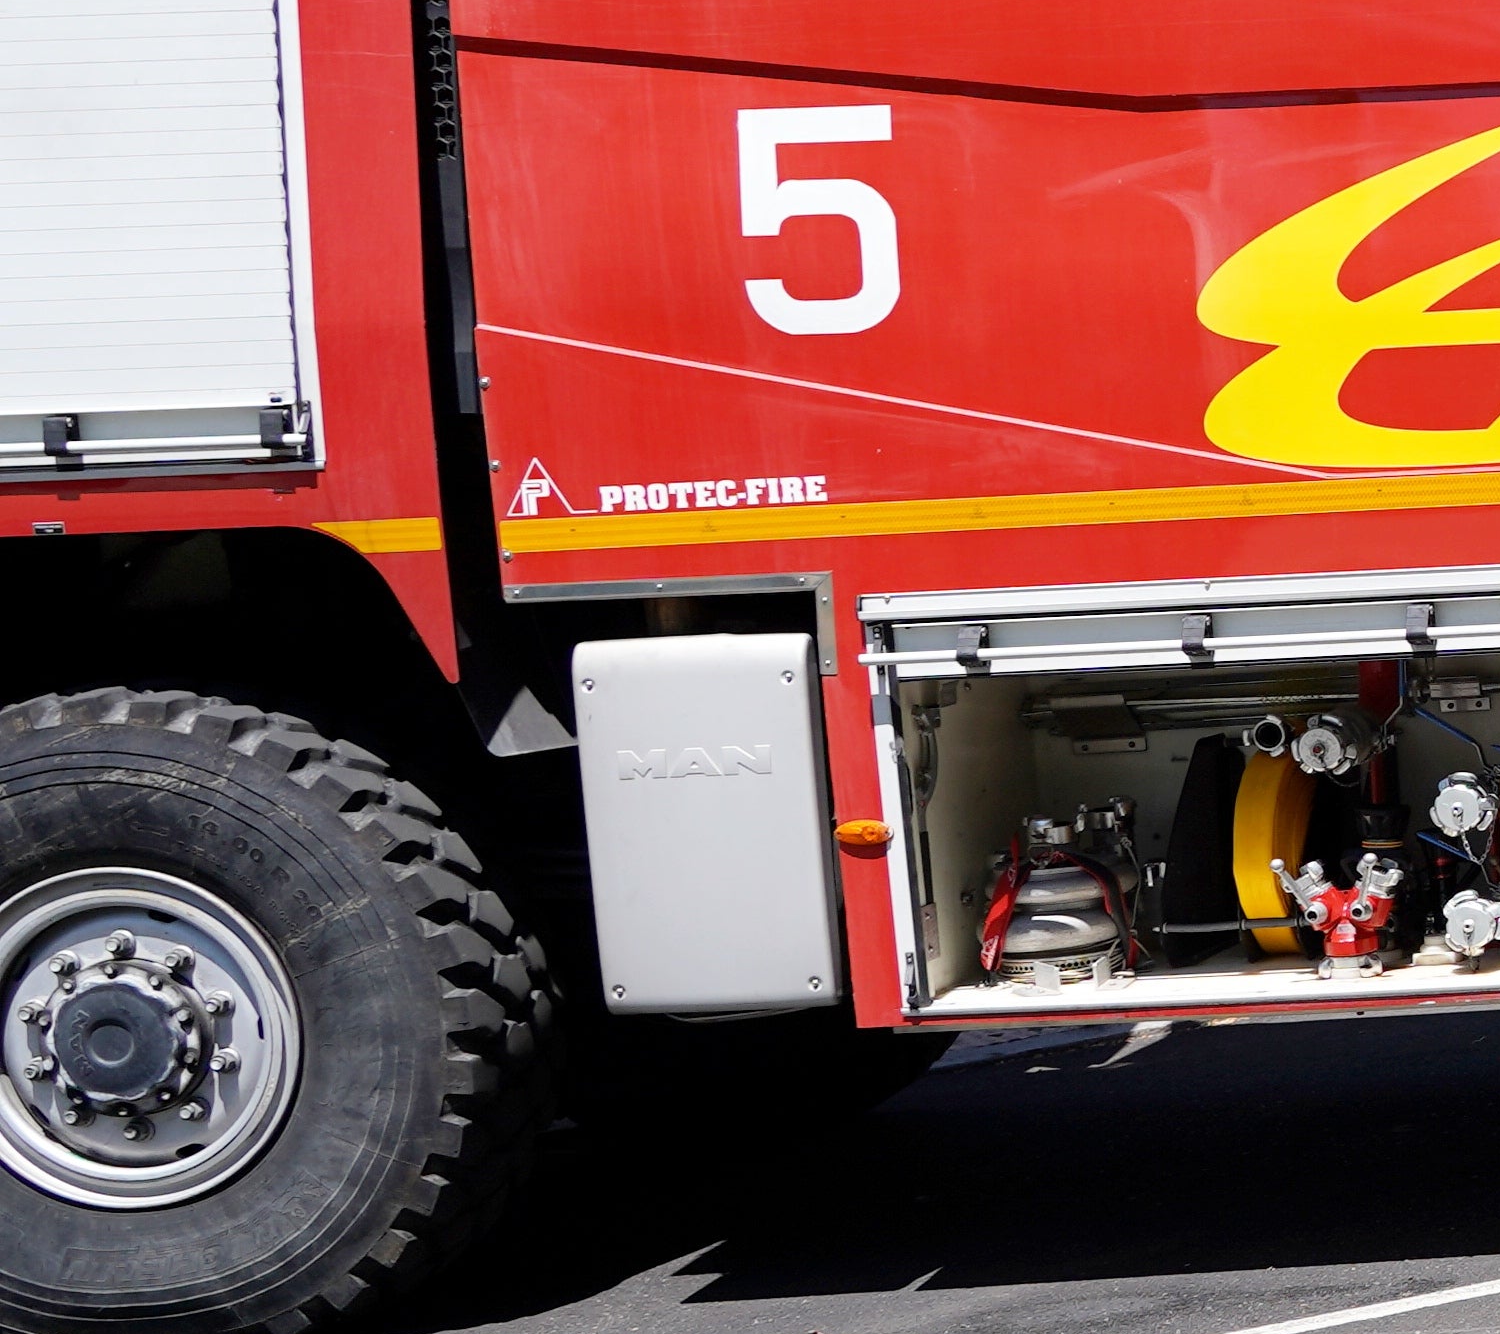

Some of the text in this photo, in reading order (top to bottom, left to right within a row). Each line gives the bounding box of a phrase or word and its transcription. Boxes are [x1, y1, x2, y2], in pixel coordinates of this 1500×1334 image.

[737, 104, 901, 335] 5
[599, 475, 829, 512] PROTEC-FIRE
[616, 744, 773, 780] MAN
